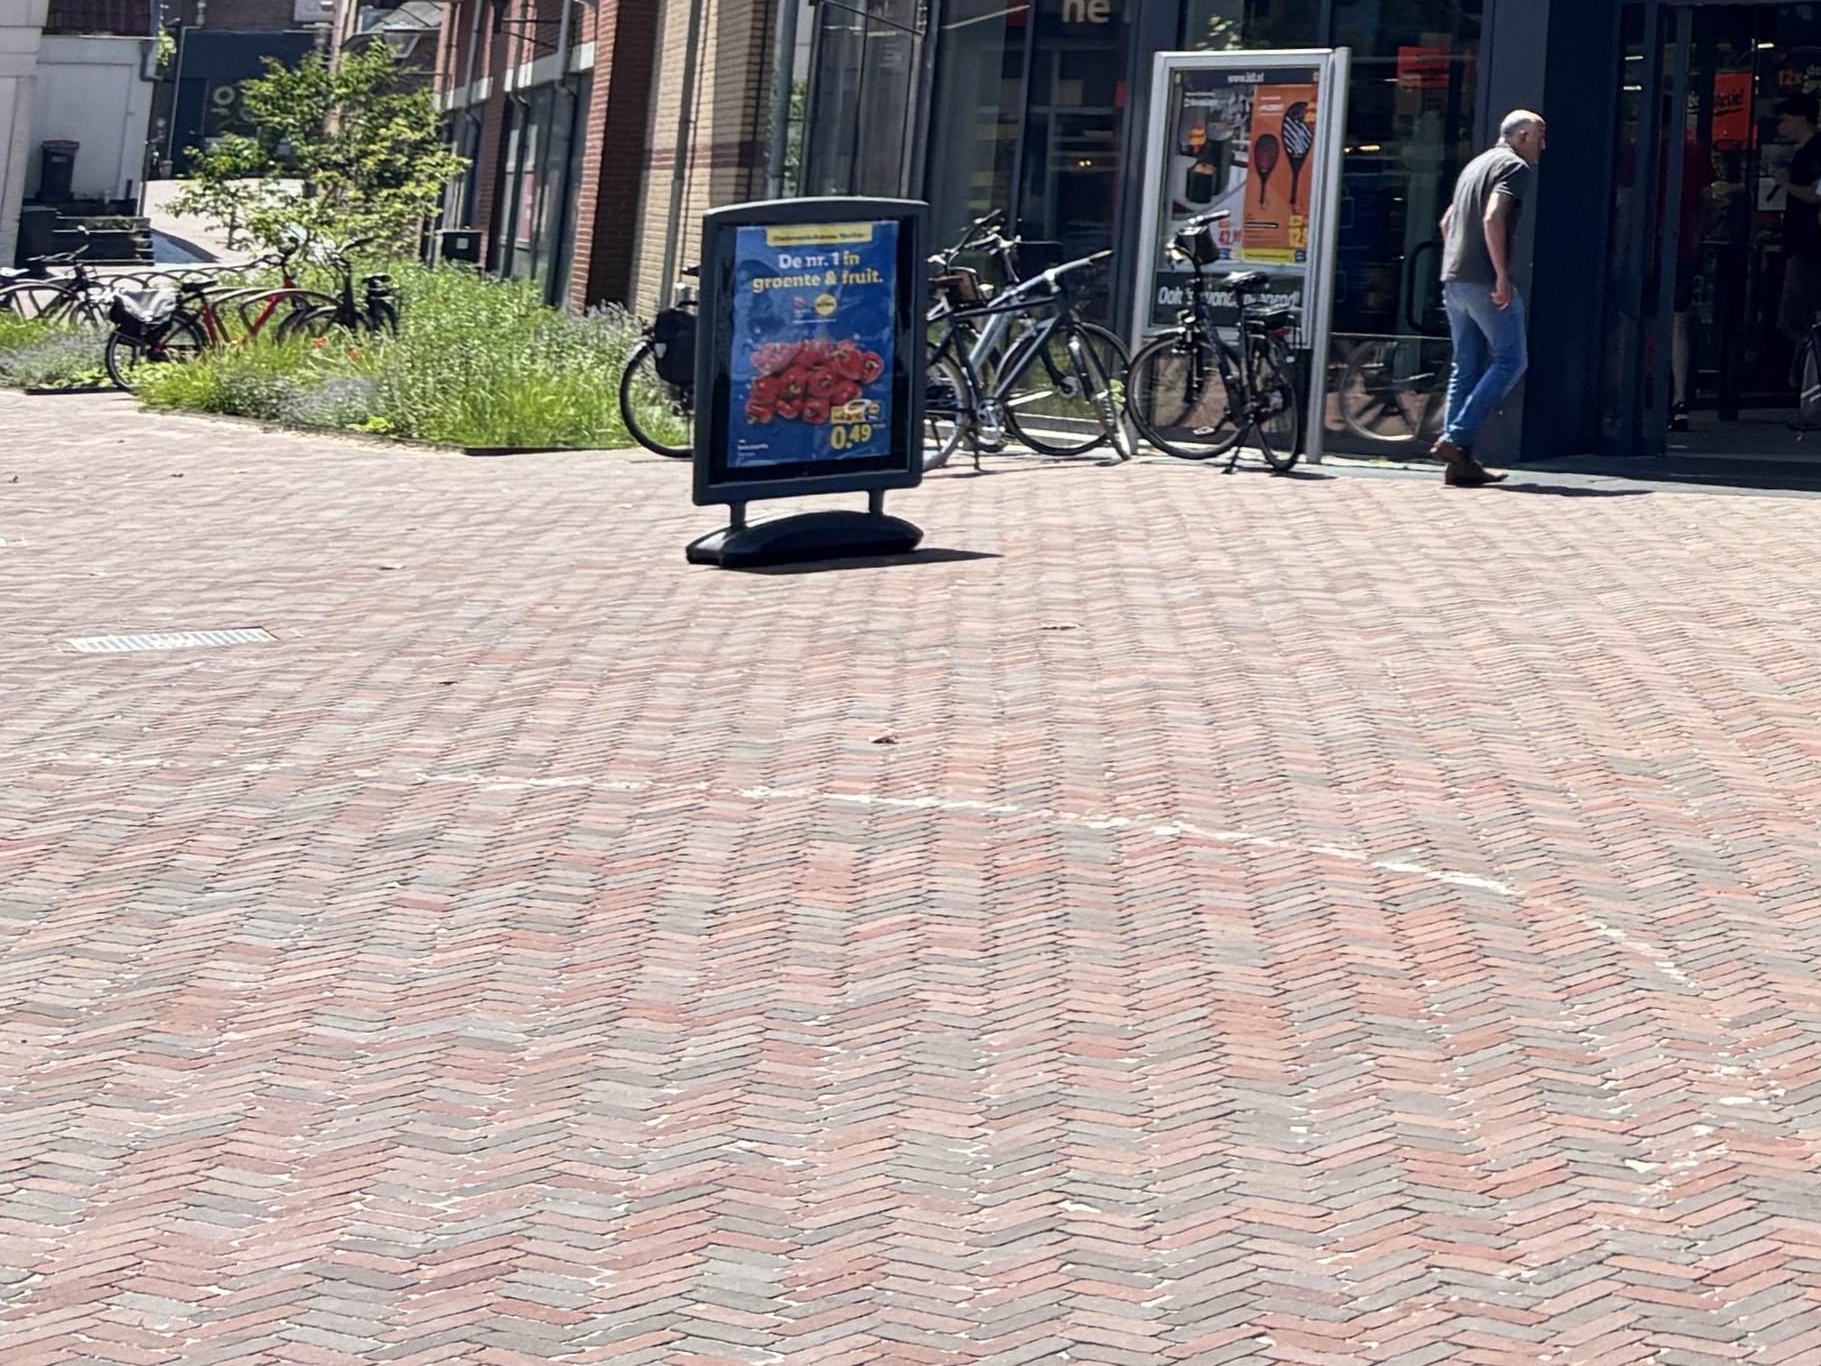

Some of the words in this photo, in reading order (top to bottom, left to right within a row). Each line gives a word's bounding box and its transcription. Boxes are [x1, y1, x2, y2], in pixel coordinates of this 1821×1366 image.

[777, 253, 802, 269] De
[805, 255, 829, 267] nr.
[831, 252, 840, 266] 1
[842, 250, 860, 266] in
[752, 272, 821, 293] groente
[823, 270, 837, 285] &
[841, 268, 884, 285] fruit.
[830, 423, 872, 450] 0.49
